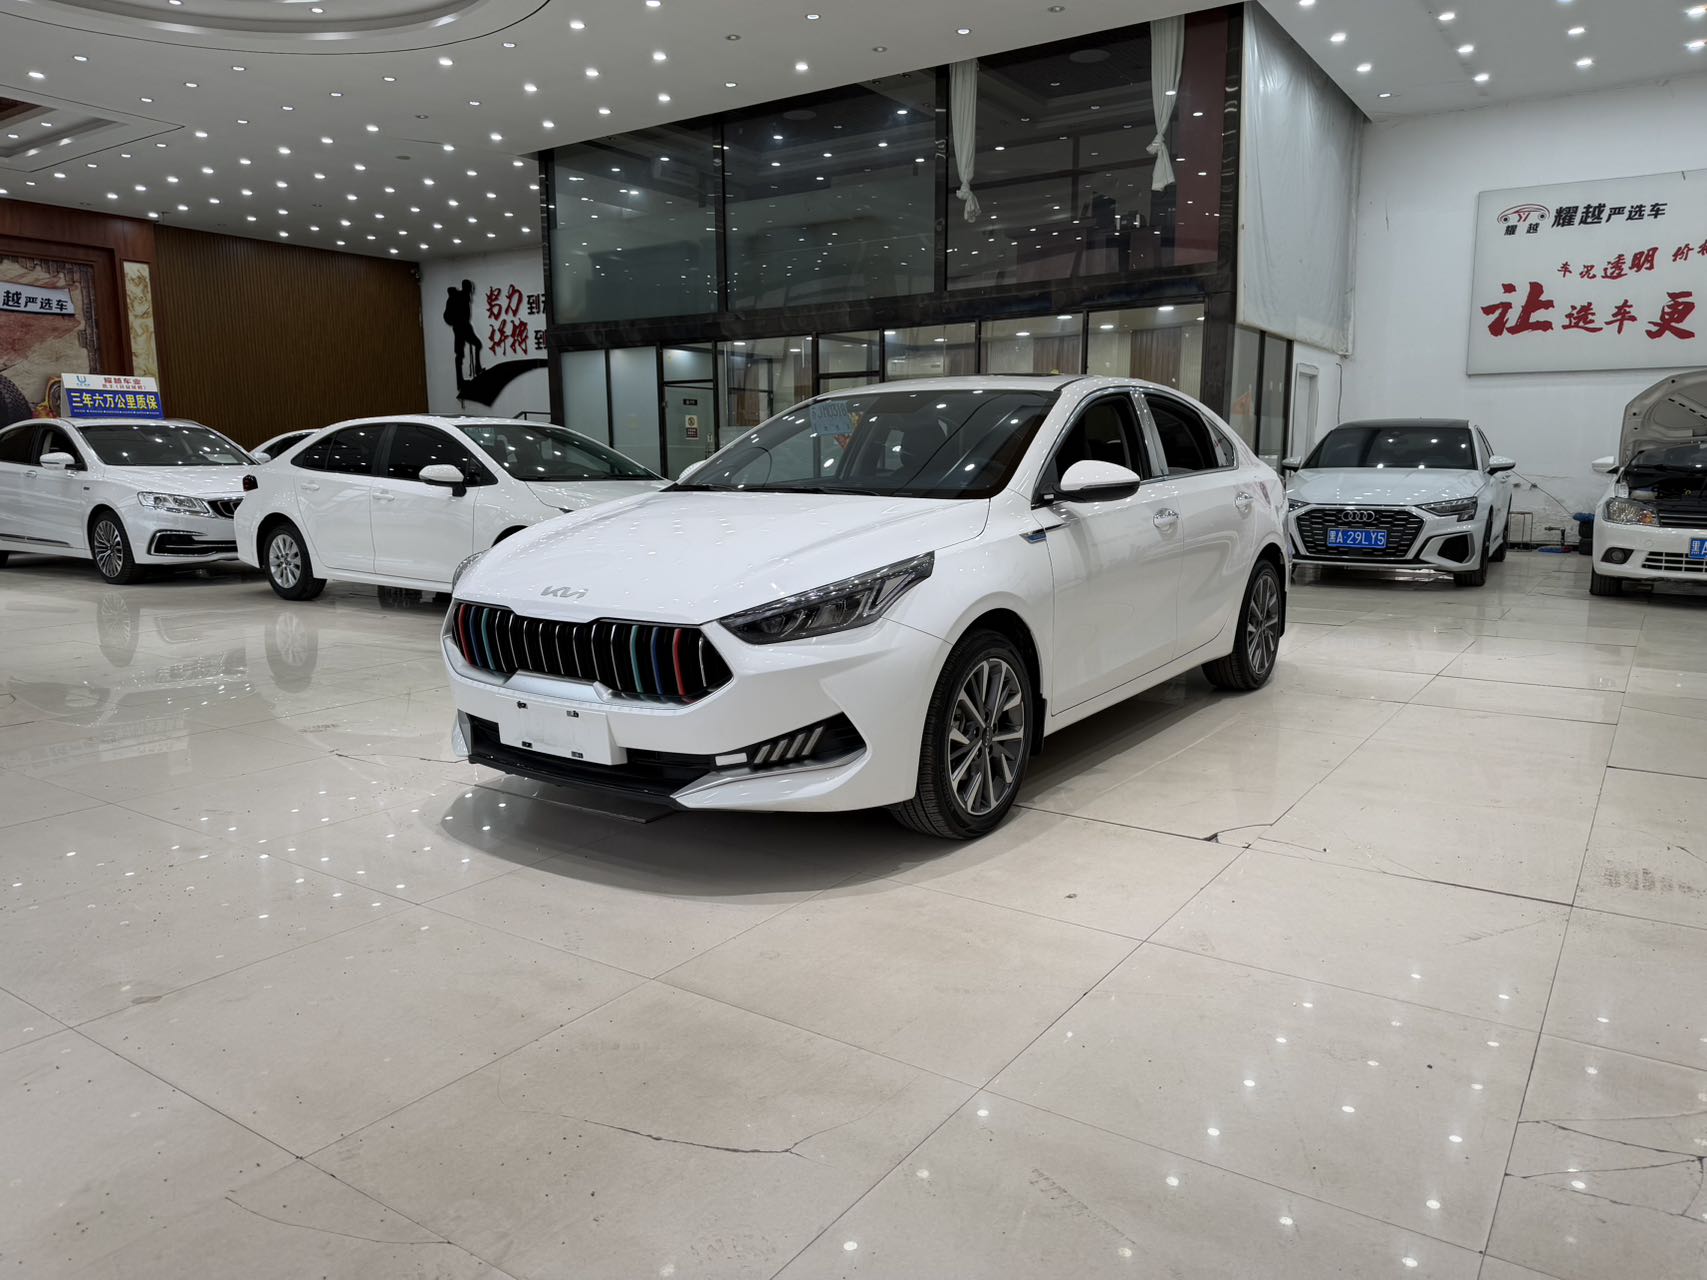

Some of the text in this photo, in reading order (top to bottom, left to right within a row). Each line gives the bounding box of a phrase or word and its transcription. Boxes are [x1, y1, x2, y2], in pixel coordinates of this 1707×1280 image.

[1551, 202, 1668, 229] 耀越严选车
[1556, 246, 1659, 281] 车况透明
[1, 289, 69, 312] 越严选车
[1480, 281, 1696, 340] 让选车更
[70, 391, 158, 410] 三年六万公里质保
